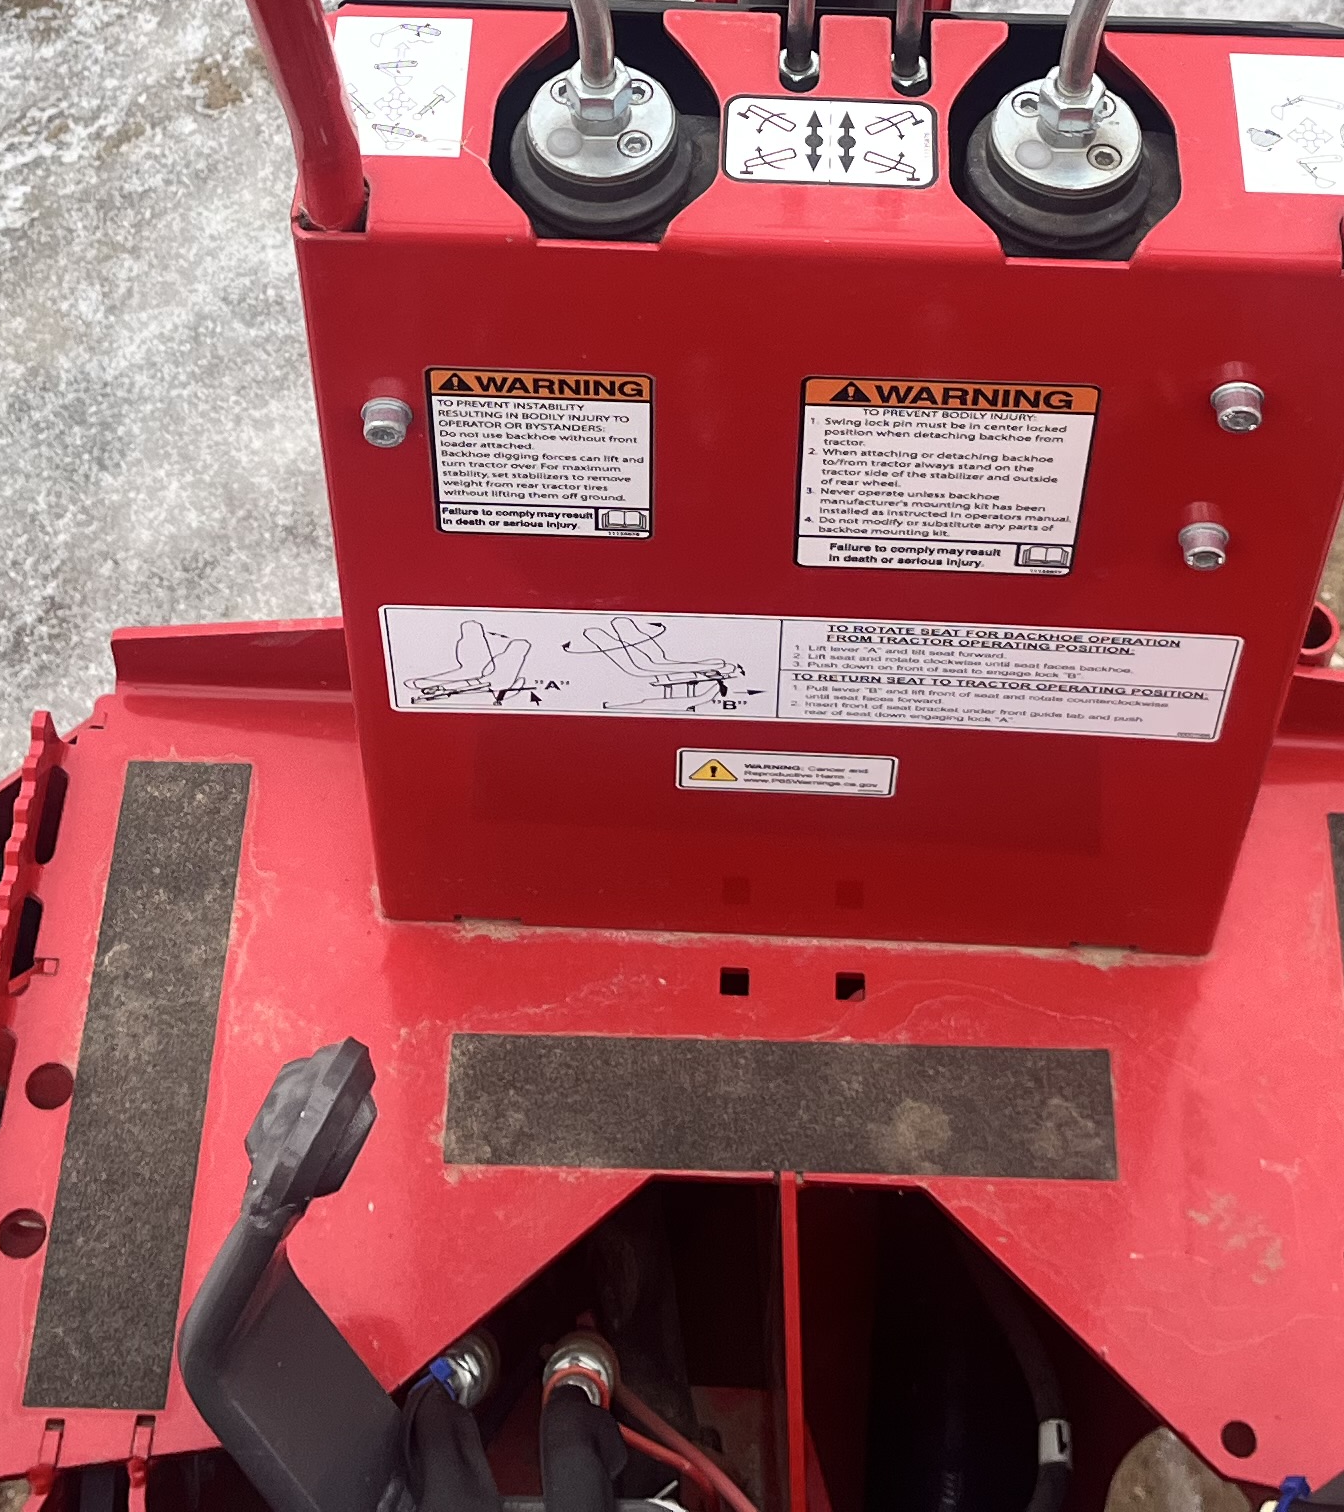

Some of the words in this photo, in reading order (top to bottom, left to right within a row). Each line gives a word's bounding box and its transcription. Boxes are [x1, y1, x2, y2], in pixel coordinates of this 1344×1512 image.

[475, 376, 643, 397] WARNING
[876, 385, 1072, 409] WARNING
[436, 399, 453, 407] TO
[456, 400, 509, 408] PREVENT
[513, 402, 584, 411] INSTABILITY
[438, 409, 502, 418] RESULTING
[522, 412, 564, 420] BODILY
[568, 414, 610, 422] INJURY
[613, 415, 629, 423] TO
[863, 408, 879, 416] TO
[883, 409, 938, 417] PREVENT
[941, 411, 987, 419] BODILY
[438, 419, 501, 428] OPERATOR
[504, 421, 522, 429] OR
[825, 417, 861, 427] Swing
[864, 418, 889, 426] lock
[892, 420, 912, 428] pin
[950, 421, 966, 429] be
[1026, 424, 1067, 433] locked
[439, 429, 456, 437] Do
[506, 432, 556, 440] backhoe
[559, 434, 605, 442] without
[608, 435, 637, 443] front
[876, 429, 910, 437] when
[913, 431, 975, 441] detaching
[979, 433, 1031, 441] backhoe
[1035, 434, 1063, 443] from
[441, 449, 490, 458] Backhoe
[493, 452, 538, 461] digging
[542, 453, 577, 461] forces
[822, 448, 857, 456] When
[860, 450, 917, 459] attaching
[936, 452, 998, 462] detaching
[1002, 454, 1053, 463] backhoe
[540, 462, 558, 470] For
[914, 461, 954, 470] always
[1014, 464, 1034, 472] the
[512, 472, 568, 480] stabilizers
[443, 479, 482, 487] weight
[485, 480, 513, 488] from
[443, 489, 488, 497] without
[491, 490, 525, 499] lifting
[442, 507, 478, 515] Failure
[481, 508, 492, 516] to
[495, 510, 535, 519] comply
[536, 511, 561, 519] may
[829, 542, 871, 552] Failure
[874, 544, 887, 552] to
[890, 546, 935, 555] comply
[936, 548, 964, 557] may
[965, 548, 1001, 556] result
[843, 555, 877, 563] death
[897, 557, 942, 565] serious
[828, 624, 848, 632] TO
[853, 625, 914, 635] ROTATE
[920, 628, 960, 637] SEAT
[964, 630, 999, 639] FOR
[1003, 631, 1083, 642] BACKHOE
[1088, 635, 1180, 647] OPERATION
[826, 634, 872, 643] FROM
[878, 636, 953, 647] TRACTOR
[958, 639, 1050, 651] OPERATING
[792, 672, 813, 680] TO
[818, 674, 881, 683] RETURN
[886, 676, 926, 685] SEAT
[930, 678, 951, 687] TO
[956, 679, 1031, 690] TRACTOR
[1035, 683, 1126, 695] OPERATING
